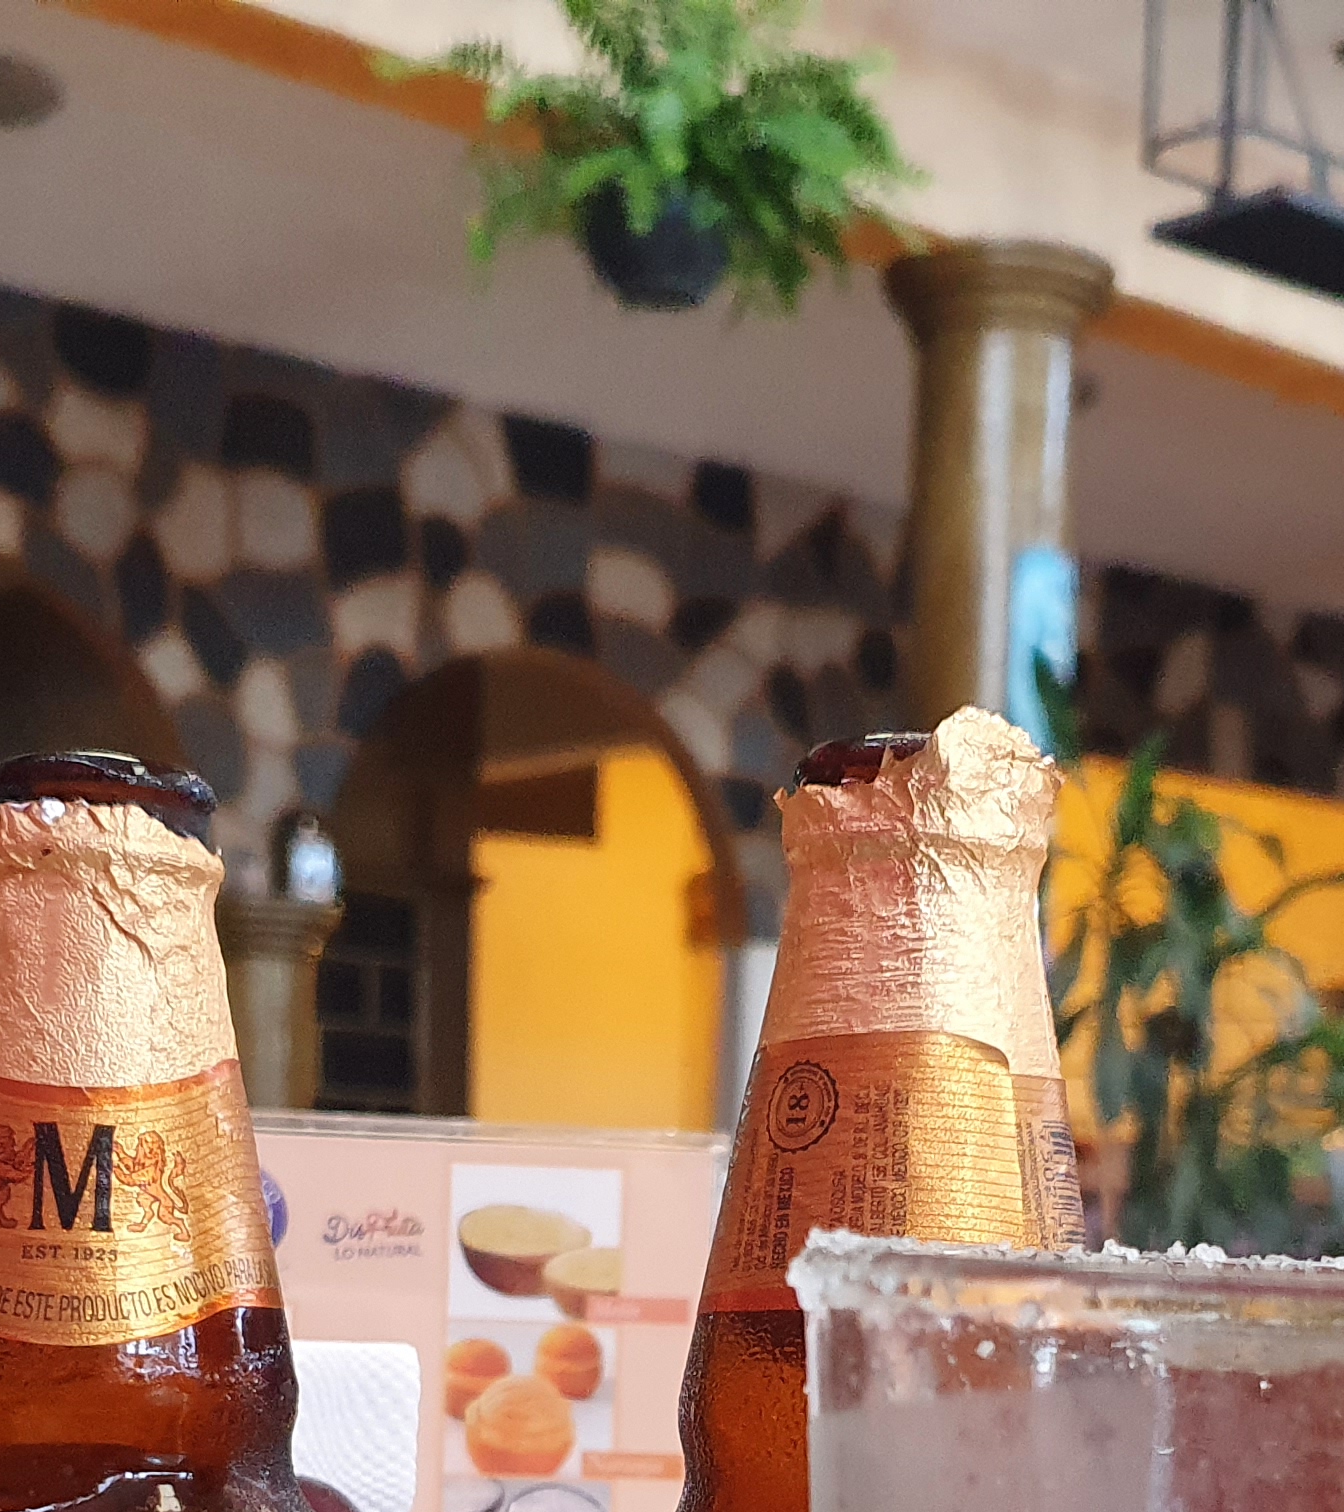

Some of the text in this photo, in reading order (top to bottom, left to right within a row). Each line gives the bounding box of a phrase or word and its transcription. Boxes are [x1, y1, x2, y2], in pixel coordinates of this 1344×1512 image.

[27, 1121, 116, 1233] M
[12, 1289, 55, 1321] ESTE
[58, 1289, 152, 1322] PRODUCTO
[153, 1285, 176, 1314] ES
[173, 1263, 225, 1306] NOCIVO
